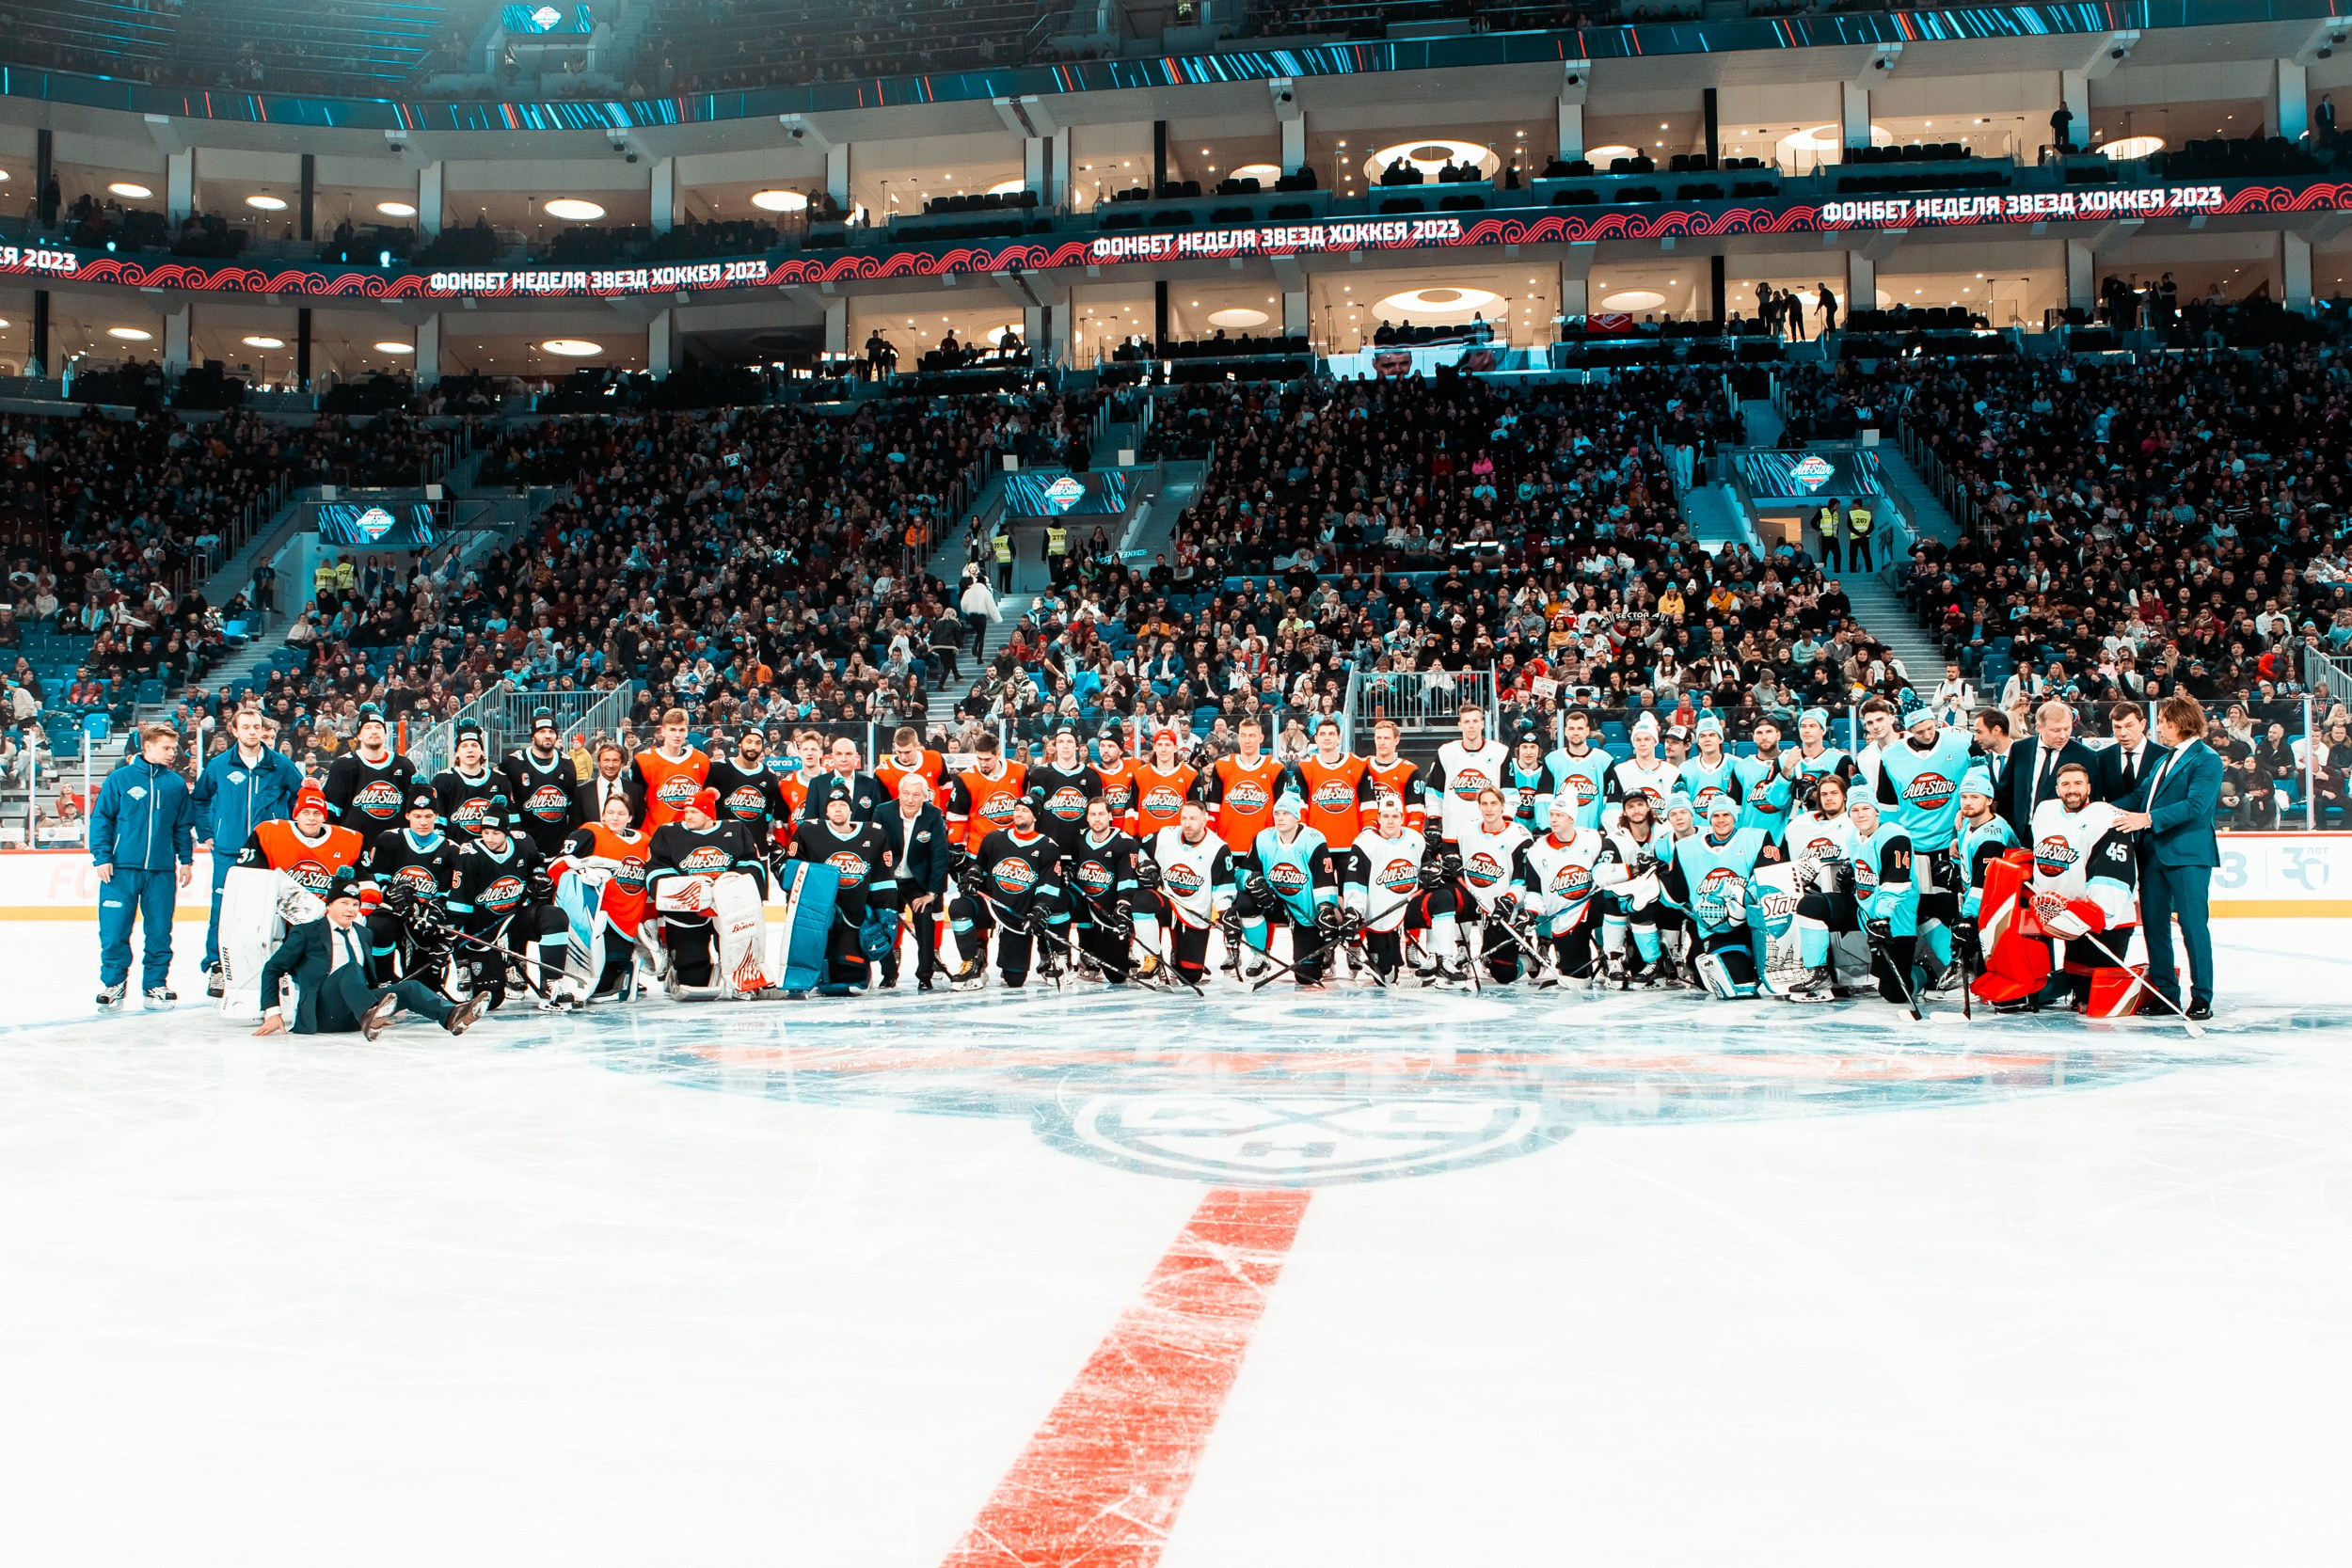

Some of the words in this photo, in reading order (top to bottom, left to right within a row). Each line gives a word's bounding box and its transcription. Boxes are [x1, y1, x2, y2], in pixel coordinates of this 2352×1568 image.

[1822, 199, 1911, 221] ФОНБЕТ
[1915, 196, 2000, 219] НЕДЕЛЯ
[2006, 193, 2074, 215] ЗВЕЗД
[2079, 188, 2164, 210] ХОККЕЯ
[2169, 186, 2222, 207] 2023
[1093, 233, 1174, 257] ФОНБЕТ
[1178, 229, 1256, 254] НЕДЕЛЯ
[1262, 226, 1325, 248] ЗВЕЗД
[1328, 221, 1407, 244] ХОККЕЯ
[1412, 218, 1460, 239] 2023
[24, 248, 75, 271] 2023
[431, 272, 508, 291] ФОНБЕТ
[512, 272, 585, 292] НЕДЕЛЯ
[591, 269, 649, 290] ЗВЕЗД
[651, 263, 721, 285] ХОККЕЯ
[724, 261, 767, 279] 2023
[1790, 465, 1835, 476] All-Star
[1044, 484, 1085, 497] All-Star
[354, 790, 403, 805] All-Star
[657, 784, 701, 798] All-Star
[1225, 788, 1269, 802] All-Star
[1902, 781, 1956, 799] All-Star
[979, 800, 1015, 815] All-Sta
[679, 853, 732, 868] All-Star
[1894, 850, 1910, 869] 14
[2106, 842, 2128, 863] 45
[993, 863, 1037, 882] All-Star
[791, 869, 805, 905] CCM
[1763, 895, 1798, 917] Star
[222, 946, 233, 981] BAUER
